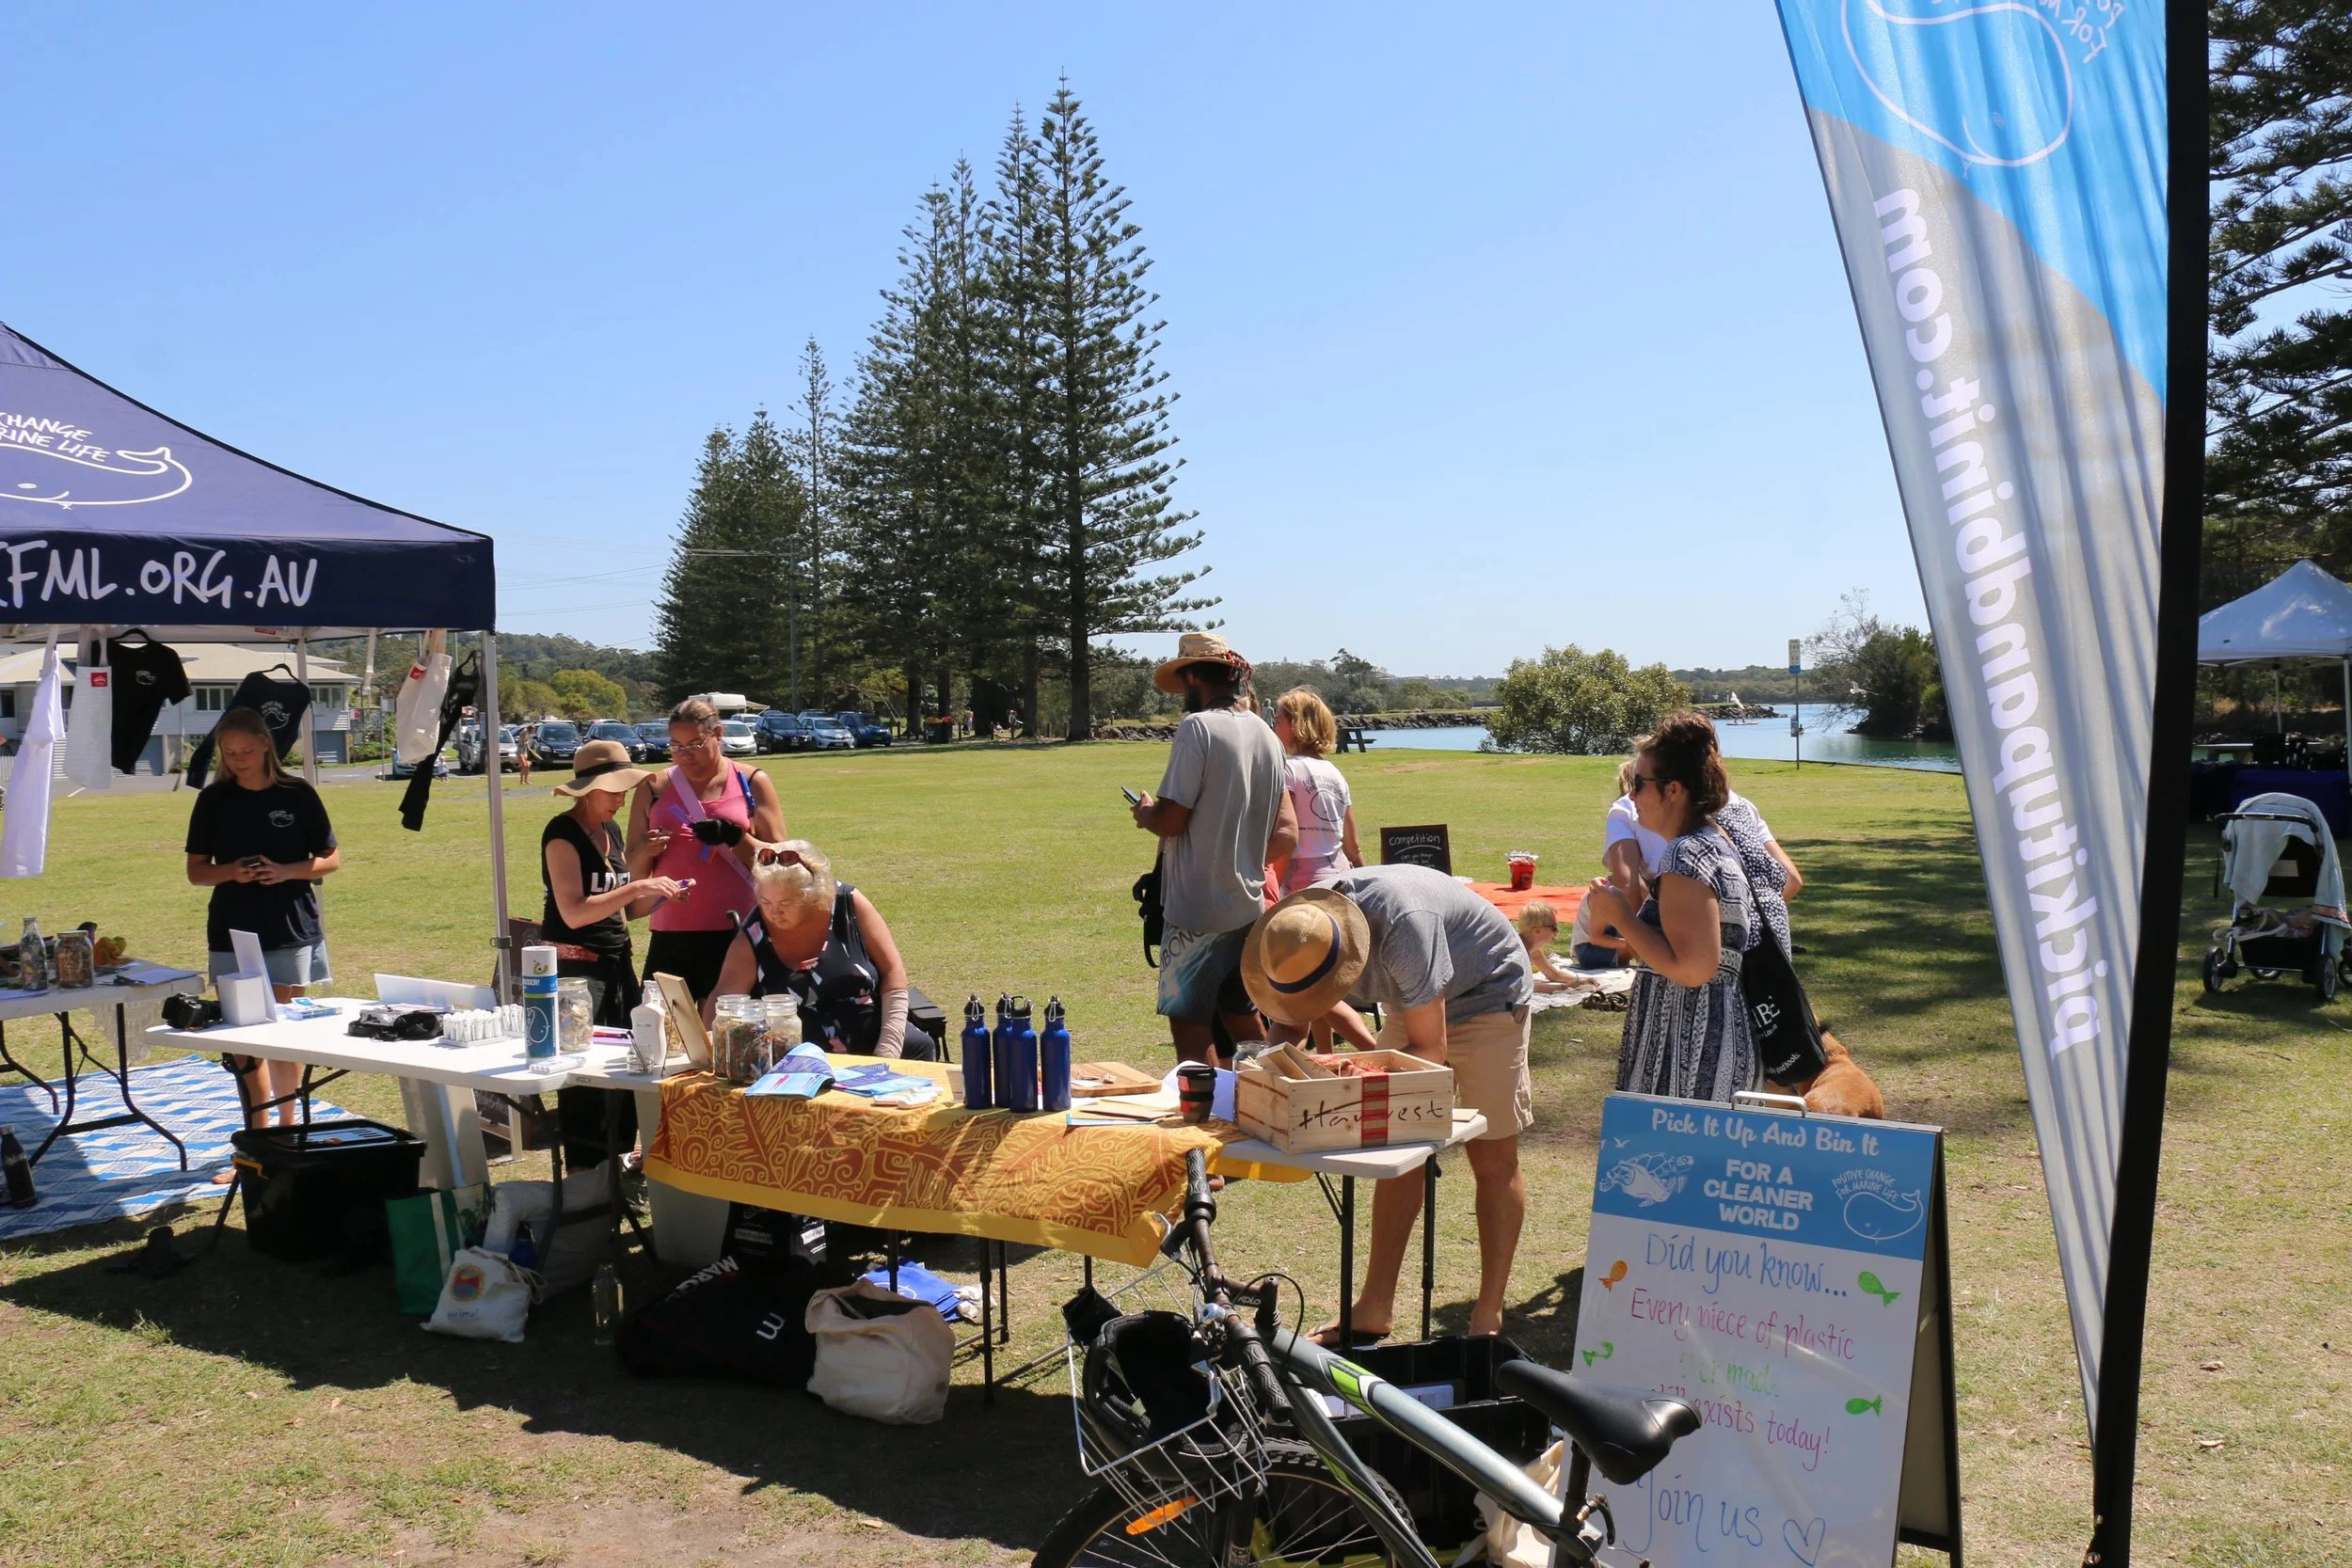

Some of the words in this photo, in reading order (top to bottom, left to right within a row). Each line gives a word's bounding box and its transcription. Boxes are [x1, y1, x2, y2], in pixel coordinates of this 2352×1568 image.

[57, 439, 111, 462] LIFE
[0, 540, 318, 609] FML.ORG.AU
[1652, 1108, 1698, 1134] Pick
[1704, 1115, 1720, 1137] It
[1725, 1117, 1757, 1148] Up
[1762, 1121, 1806, 1148] And
[1816, 1127, 1855, 1153] Bin
[1862, 1132, 1880, 1156] It
[1726, 1159, 1772, 1182] FOR
[1776, 1166, 1793, 1185] A
[1831, 1169, 1863, 1188] POSITIVE
[1865, 1168, 1896, 1187] CHANGE
[1836, 1184, 1852, 1200] FOR
[1852, 1180, 1882, 1193] MARINE
[1883, 1187, 1899, 1202] LIFE
[1703, 1179, 1814, 1212] CLEANER
[1719, 1203, 1800, 1231] WORLD
[1646, 1233, 1695, 1272] Did
[1702, 1246, 1752, 1294] you
[1630, 1287, 1691, 1341] Every
[1756, 1310, 1778, 1350] of
[1784, 1314, 1855, 1360] plastic
[1767, 1409, 1830, 1472] today!
[1623, 1467, 1709, 1553] Join
[1721, 1501, 1763, 1547] us
